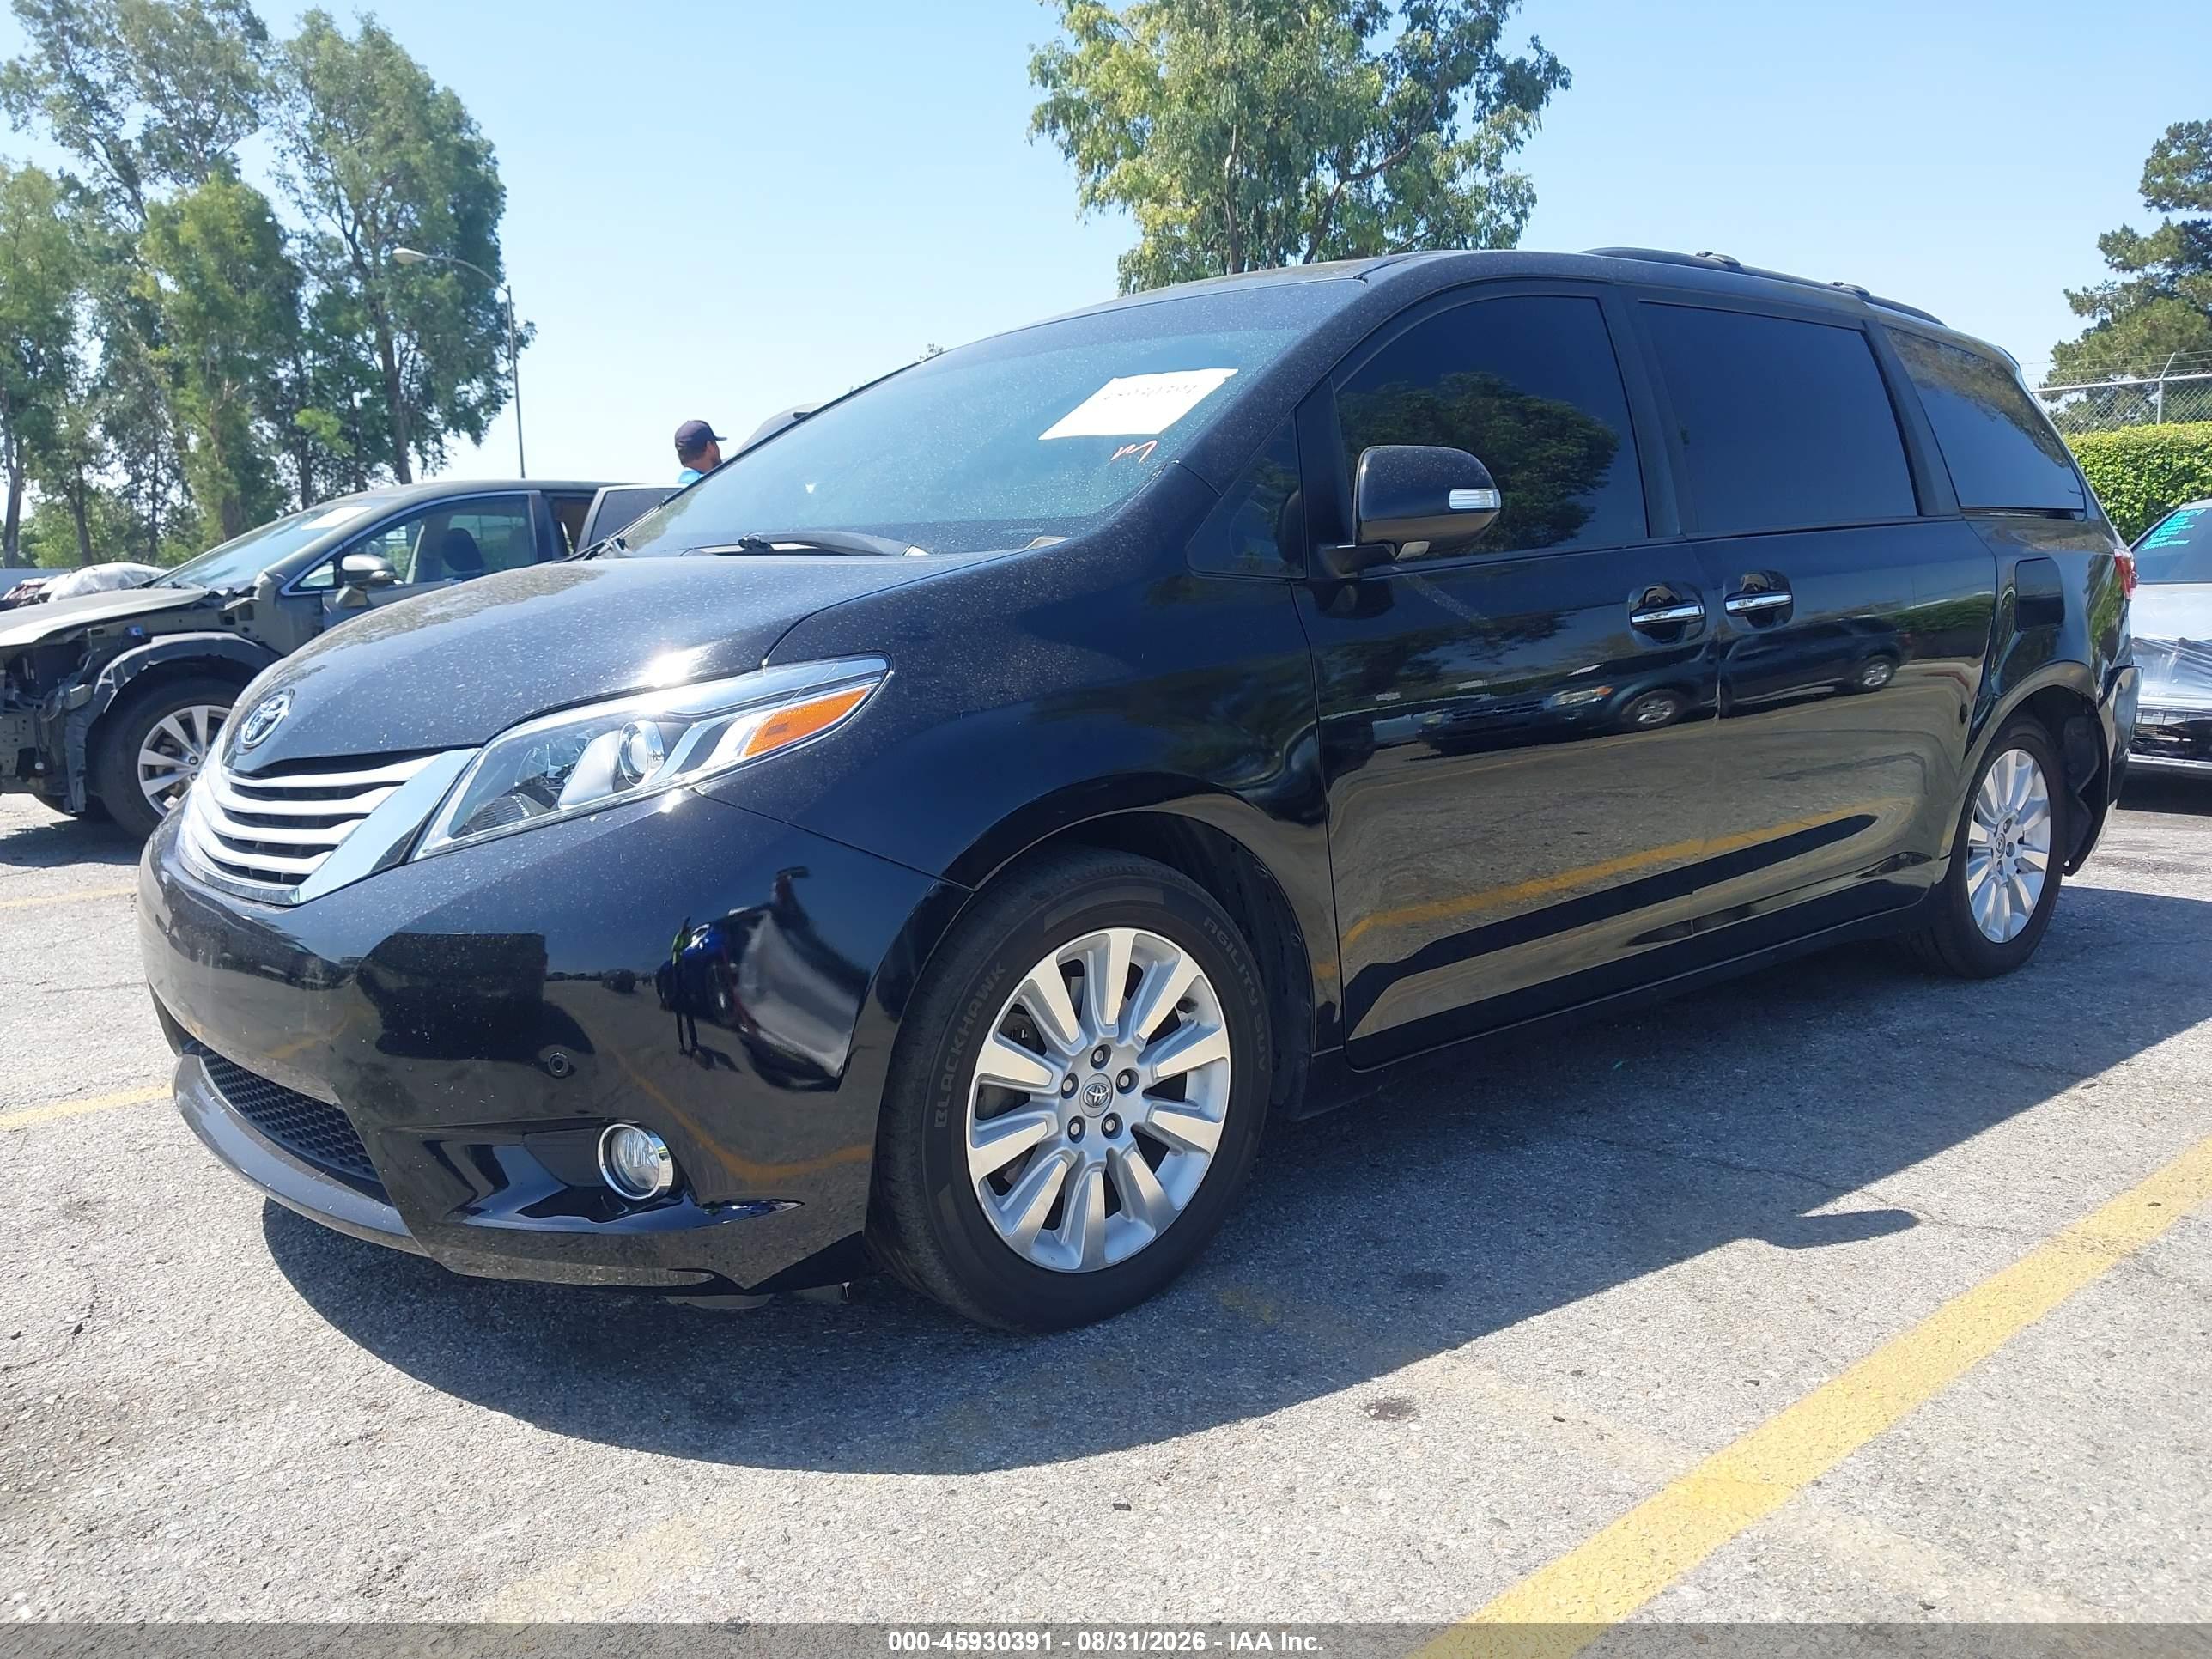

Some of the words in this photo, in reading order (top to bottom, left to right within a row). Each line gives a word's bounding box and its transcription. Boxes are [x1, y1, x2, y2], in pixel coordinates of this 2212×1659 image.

[934, 961, 1007, 1128] BLACKHAWK
[1203, 916, 1259, 1006] AGILITY
[1254, 1012, 1267, 1072] SUV
